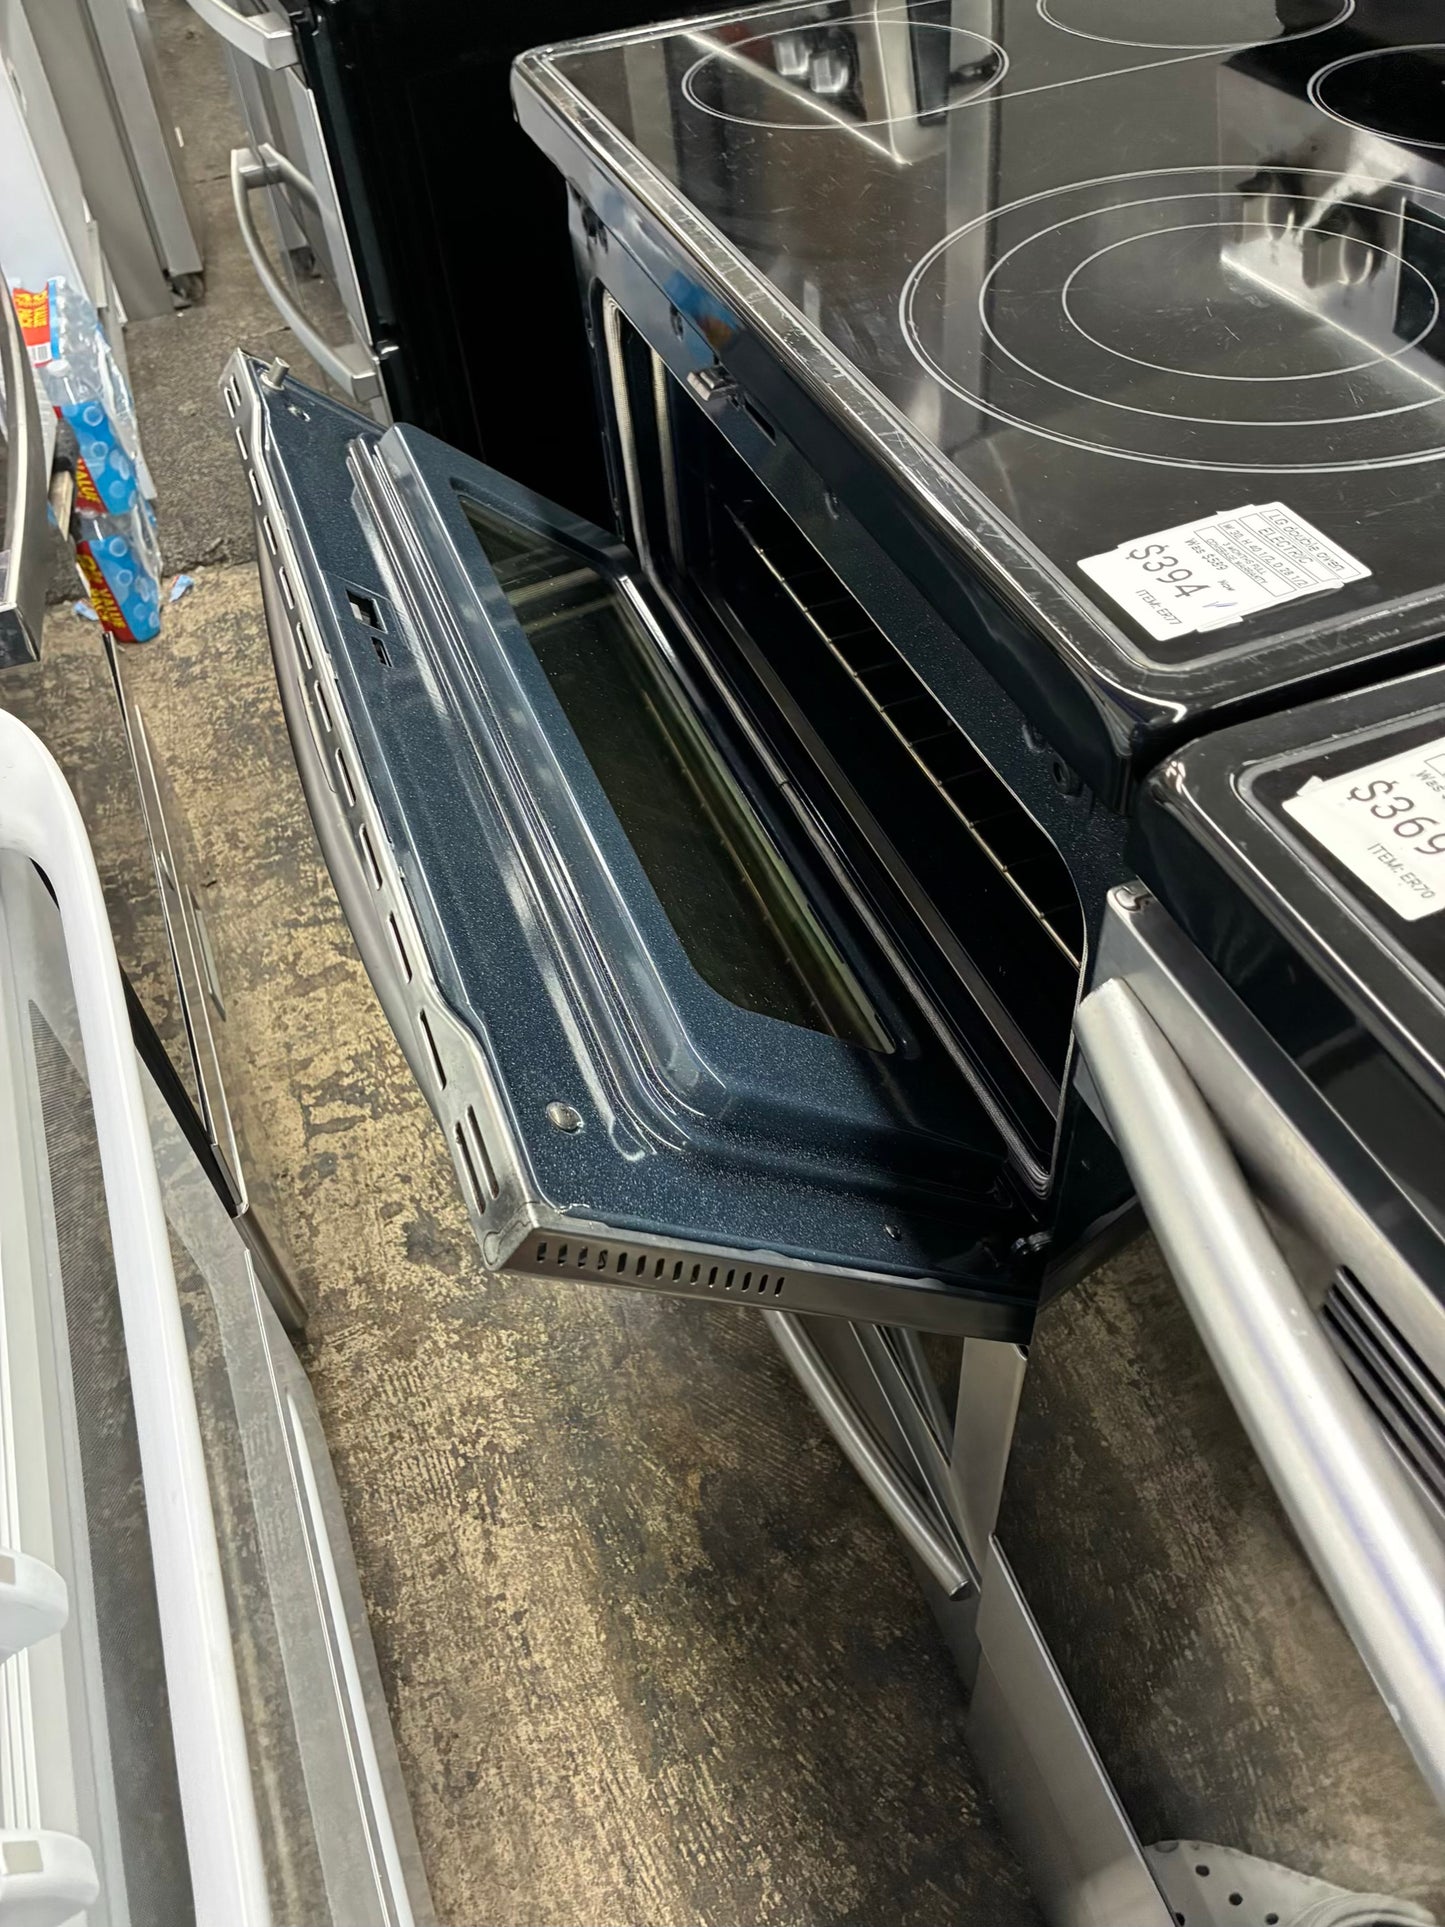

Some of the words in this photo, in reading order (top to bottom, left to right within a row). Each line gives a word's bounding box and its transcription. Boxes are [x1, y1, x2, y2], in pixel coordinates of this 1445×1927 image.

[1184, 538, 1206, 554] Was
[1228, 546, 1254, 564] MONTHS
[1252, 563, 1267, 575] FULL
[1258, 527, 1313, 563] ELECTRIC
[1269, 514, 1288, 525] LG
[1283, 526, 1320, 551] double
[1317, 552, 1345, 571] oven
[1125, 544, 1211, 598] $394
[1135, 589, 1161, 610] ITEM:
[1156, 608, 1183, 624] ER77
[1347, 780, 1445, 854] $369
[1367, 842, 1405, 873] ITEM:
[1399, 872, 1436, 899] ER70
